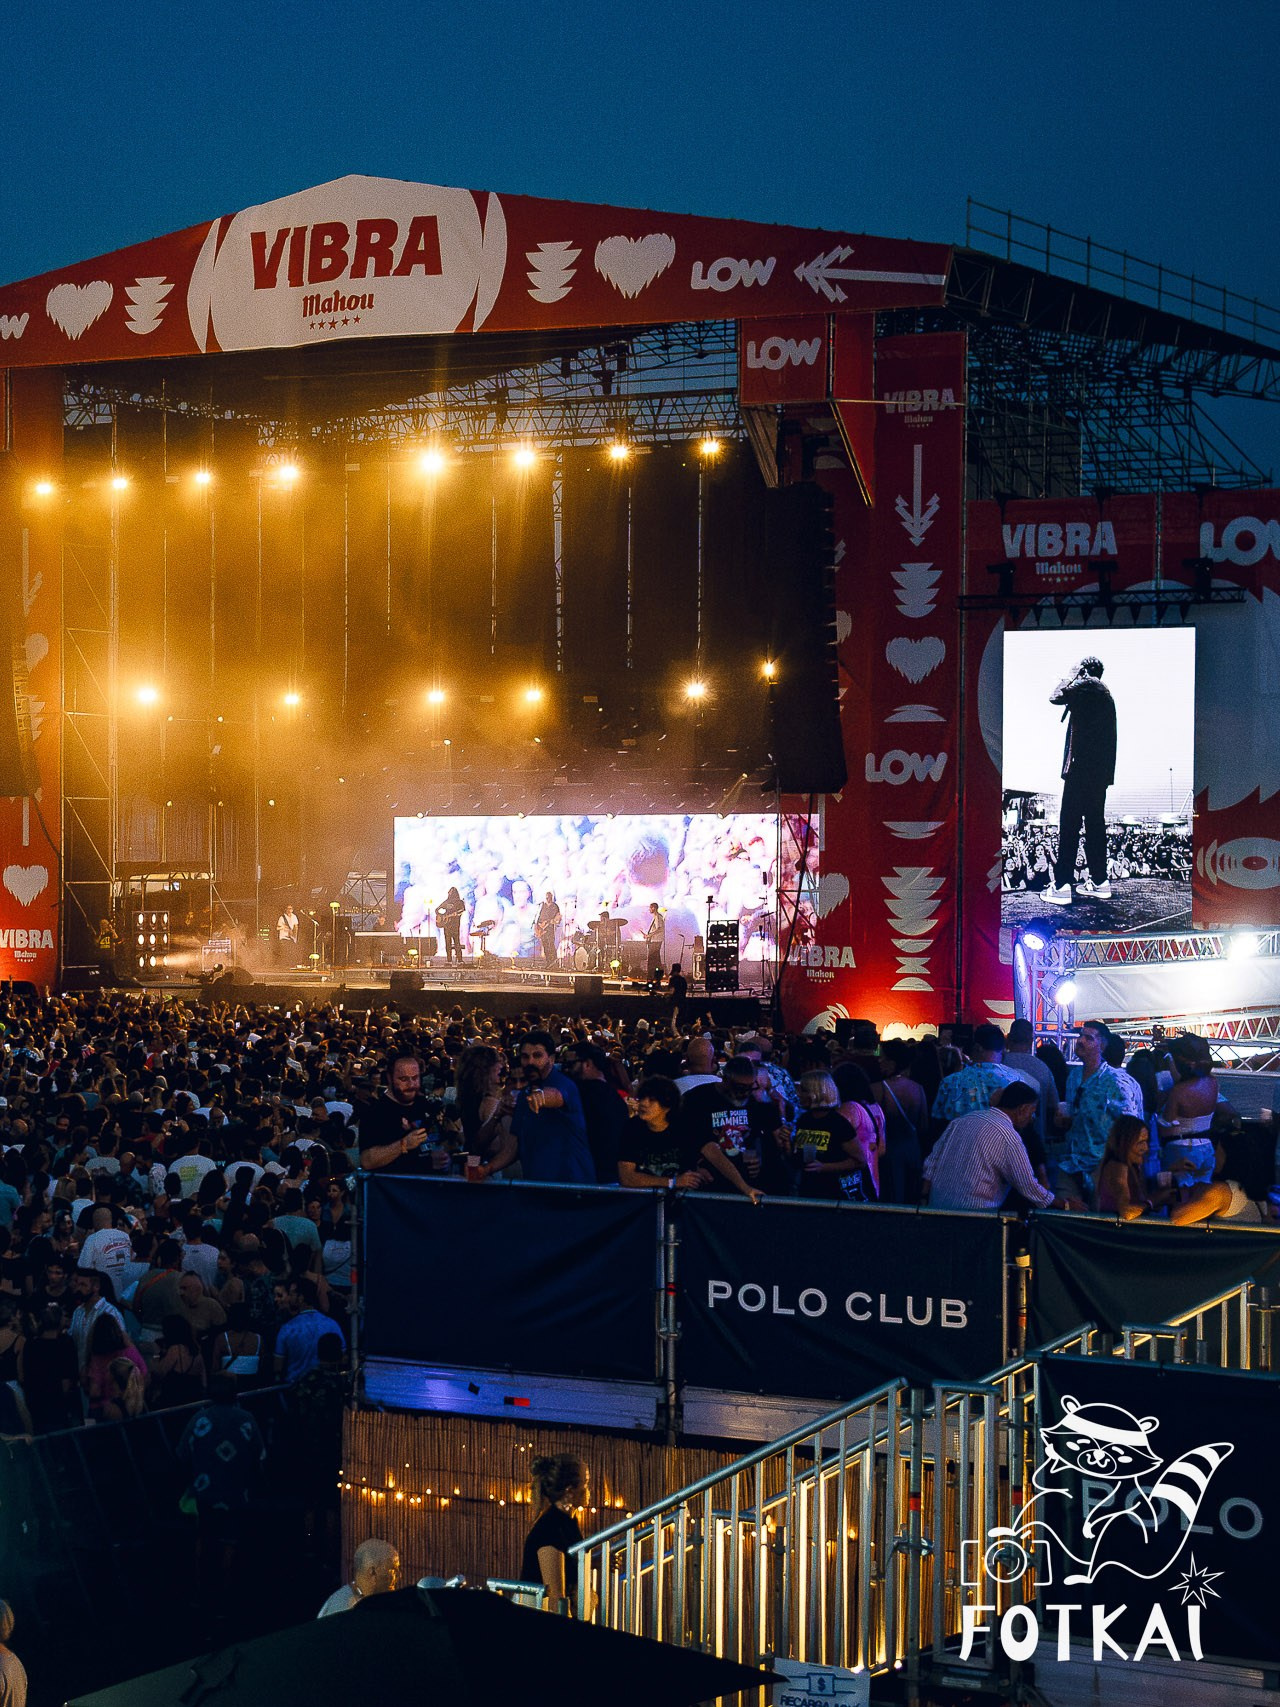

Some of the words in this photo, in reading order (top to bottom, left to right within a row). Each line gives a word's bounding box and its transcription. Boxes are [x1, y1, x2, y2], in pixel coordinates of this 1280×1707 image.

[250, 216, 441, 290] VIBRA
[690, 257, 776, 291] LOW
[747, 336, 821, 370] LOW
[883, 388, 956, 413] VIBRA
[1002, 521, 1118, 558] VIBRA
[865, 749, 948, 785] LOW
[787, 945, 856, 968] VIBRA
[712, 1115, 749, 1128] HAMMER
[708, 1280, 827, 1317] POLO
[845, 1291, 968, 1328] CLUB
